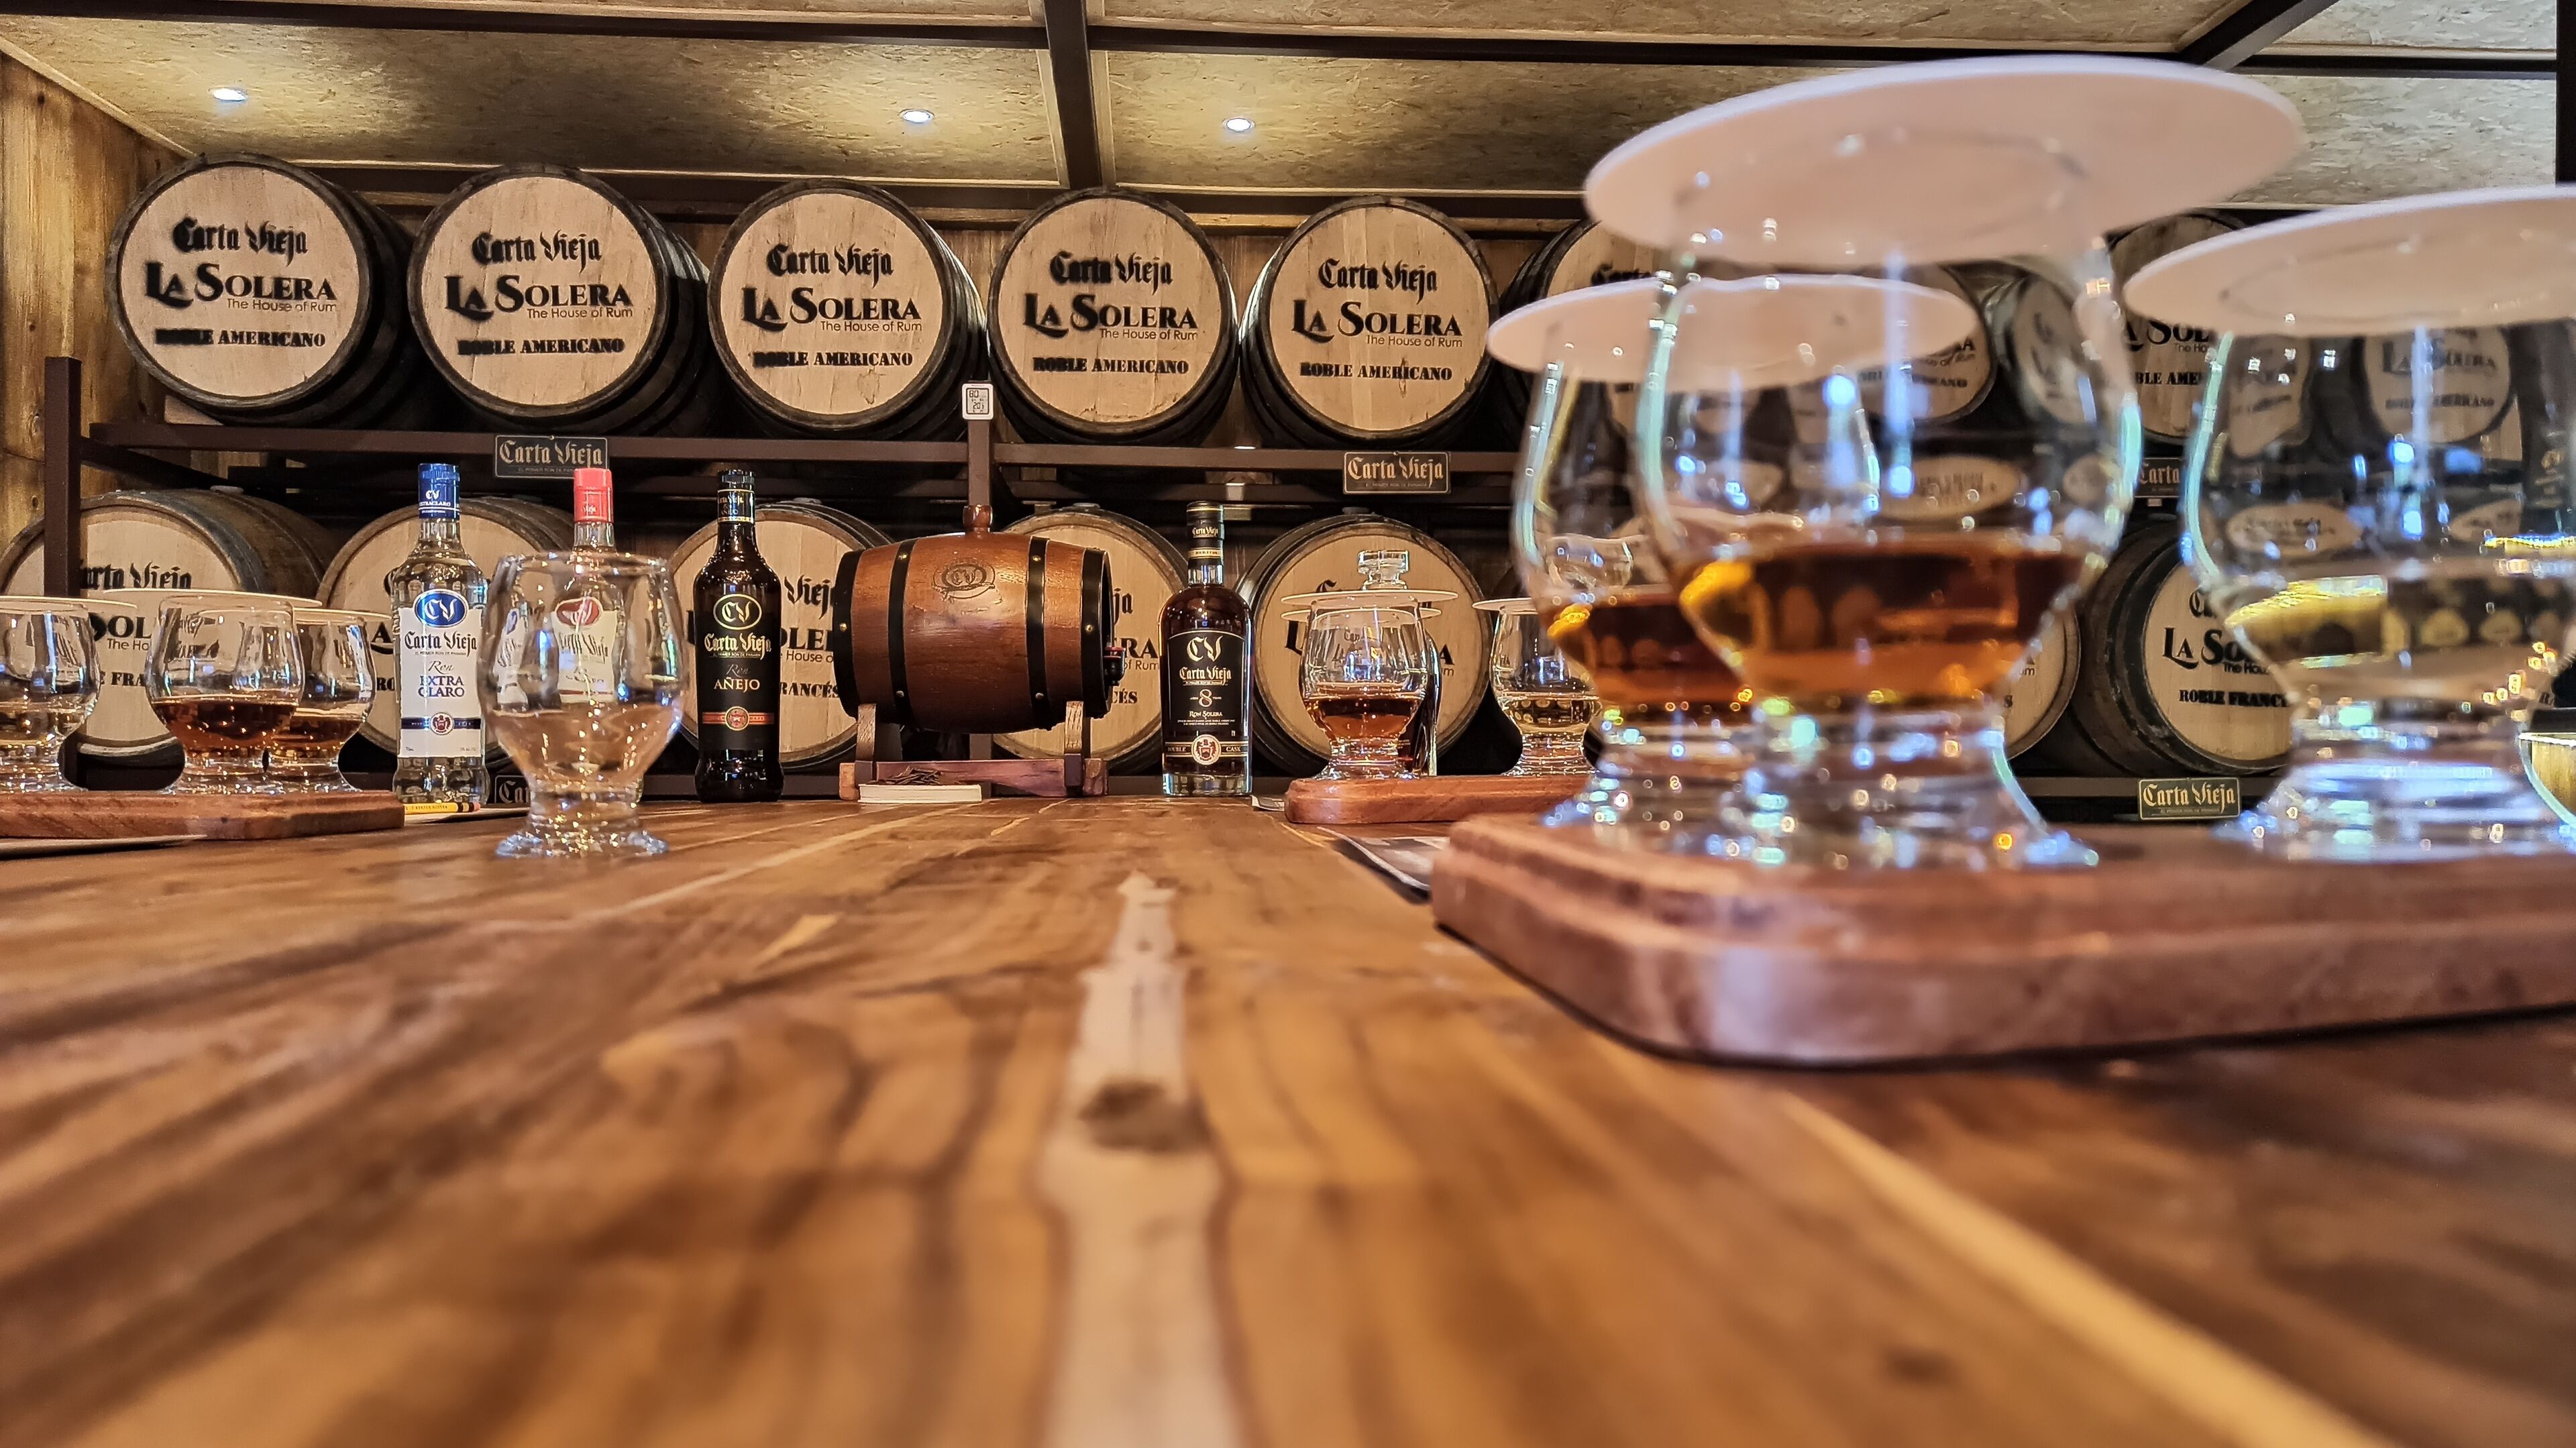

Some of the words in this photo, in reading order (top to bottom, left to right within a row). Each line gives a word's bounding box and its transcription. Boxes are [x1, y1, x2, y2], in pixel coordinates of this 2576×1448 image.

[172, 216, 240, 254] Carta
[245, 220, 309, 267] Vieja
[472, 231, 535, 266] Carta
[539, 229, 602, 274] Vieja
[767, 243, 830, 277] Carta
[834, 243, 894, 289] Vieja
[1049, 250, 1112, 285] Carta
[1114, 252, 1173, 296] Vieja
[195, 263, 338, 302] SOLERA
[1318, 258, 1381, 290] Carta
[1381, 259, 1438, 305] Vieja
[495, 275, 634, 313] SOLERA
[227, 298, 248, 309] The
[253, 300, 292, 313] House
[295, 300, 308, 313] of
[311, 301, 337, 313] Rum
[527, 308, 548, 319] The
[551, 308, 588, 319] House
[591, 307, 604, 319] of
[606, 307, 633, 319] Rum
[790, 287, 922, 325] SOLERA
[1070, 294, 1199, 332] SOLERA
[820, 321, 841, 332] The
[845, 321, 879, 333] House
[883, 321, 895, 332] of
[897, 321, 922, 332] Rum
[1338, 301, 1463, 337] SOLERA
[217, 330, 326, 347] AMERICANO
[1100, 329, 1120, 339] The
[1122, 329, 1157, 340] House
[1159, 329, 1172, 340] of
[1173, 329, 1198, 341] Rum
[1366, 335, 1385, 346] The
[1388, 336, 1422, 347] House
[1424, 336, 1436, 347] of
[1438, 337, 1463, 348] Rum
[520, 338, 625, 355] AMERICANO
[814, 352, 914, 367] AMERICANO
[1091, 357, 1189, 375] AMERICANO
[1299, 362, 1354, 378] ROBLE
[1356, 364, 1453, 382] AMERICANO
[499, 440, 551, 464] Carta
[555, 441, 602, 468] Vieja
[1348, 457, 1396, 480] Carta
[1399, 456, 1444, 488] Vieja
[784, 575, 834, 620] Viej
[424, 599, 458, 622] CV
[722, 601, 751, 623] CV
[107, 638, 129, 650] The
[405, 631, 442, 650] Carta
[443, 630, 478, 657] Vieja
[704, 632, 739, 652] Carta
[739, 632, 771, 661] Vieja
[1186, 636, 1224, 663] CV
[786, 649, 823, 663] House
[428, 661, 455, 675] Ron
[726, 663, 749, 679] Ron
[1179, 666, 1206, 681] Carta
[1206, 665, 1232, 686] Vieja
[419, 675, 464, 686] EXTRA
[713, 676, 761, 693] AÑEJO
[418, 687, 465, 698] CLARO
[1198, 689, 1213, 708] 8
[2142, 783, 2189, 807] Carta
[2192, 781, 2236, 815] Vieja
